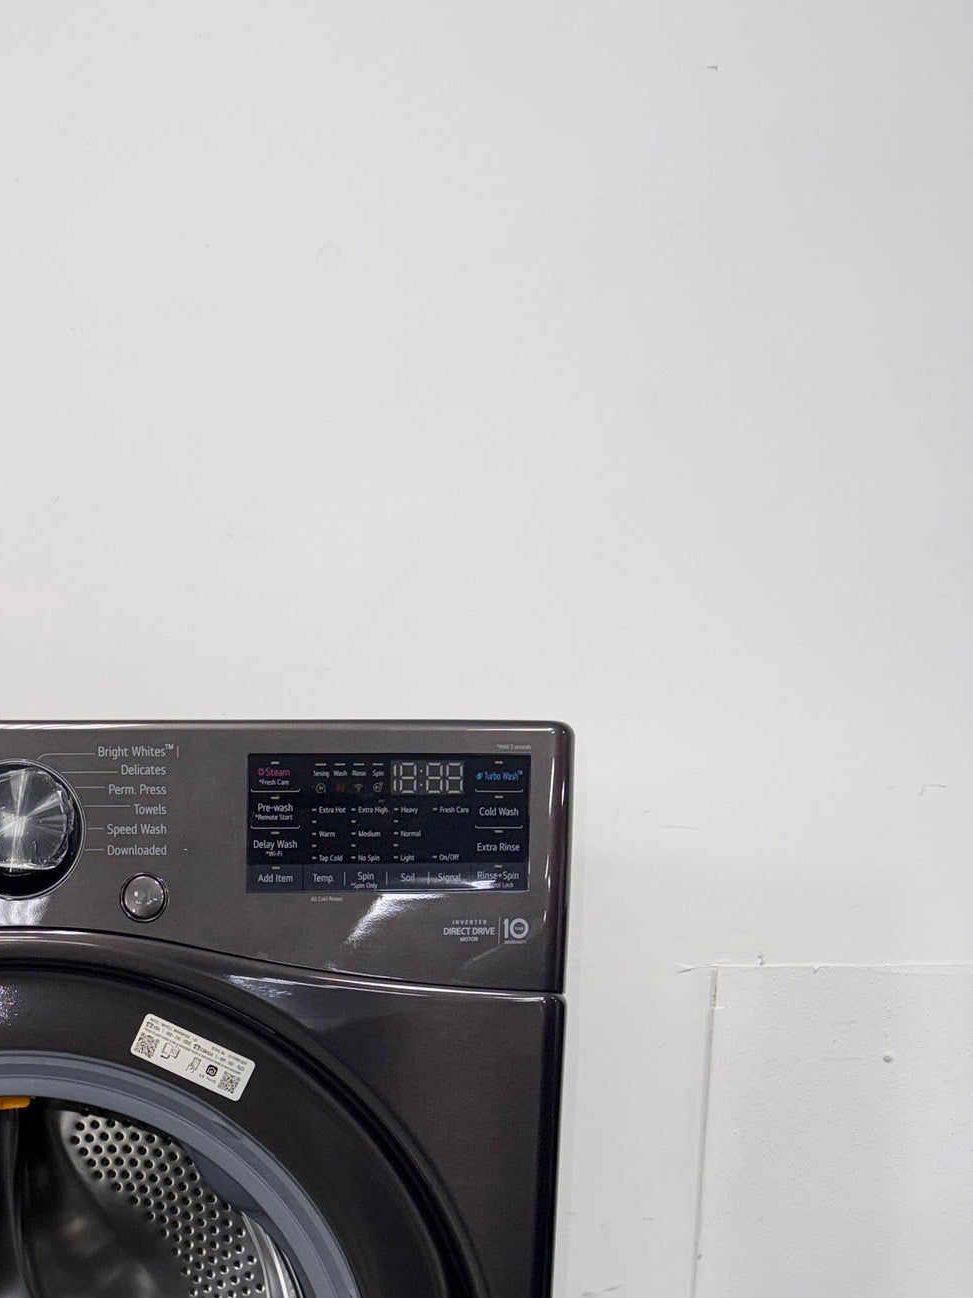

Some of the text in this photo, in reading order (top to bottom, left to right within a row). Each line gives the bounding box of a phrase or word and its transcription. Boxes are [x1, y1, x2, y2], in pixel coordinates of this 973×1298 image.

[98, 745, 129, 760] Bright
[121, 764, 166, 776] Delicates
[266, 768, 290, 776] Steam
[484, 772, 501, 780] Turbo
[109, 784, 166, 795] Perm. Press
[134, 804, 166, 815] Towels
[258, 803, 293, 812] Pre-wash
[479, 807, 519, 816] Cold Wash
[108, 824, 166, 836] Speed Wash
[254, 840, 298, 850] Delay Wash
[477, 843, 520, 851] Extra Rinse
[108, 845, 167, 856] Downloaded
[258, 874, 293, 882] Add Item
[313, 874, 334, 883] Temp.
[358, 872, 374, 881] Spin
[401, 873, 415, 882] Soil
[438, 873, 461, 884] Signal
[477, 871, 519, 881] Rinse+Spin
[504, 918, 529, 939] 10
